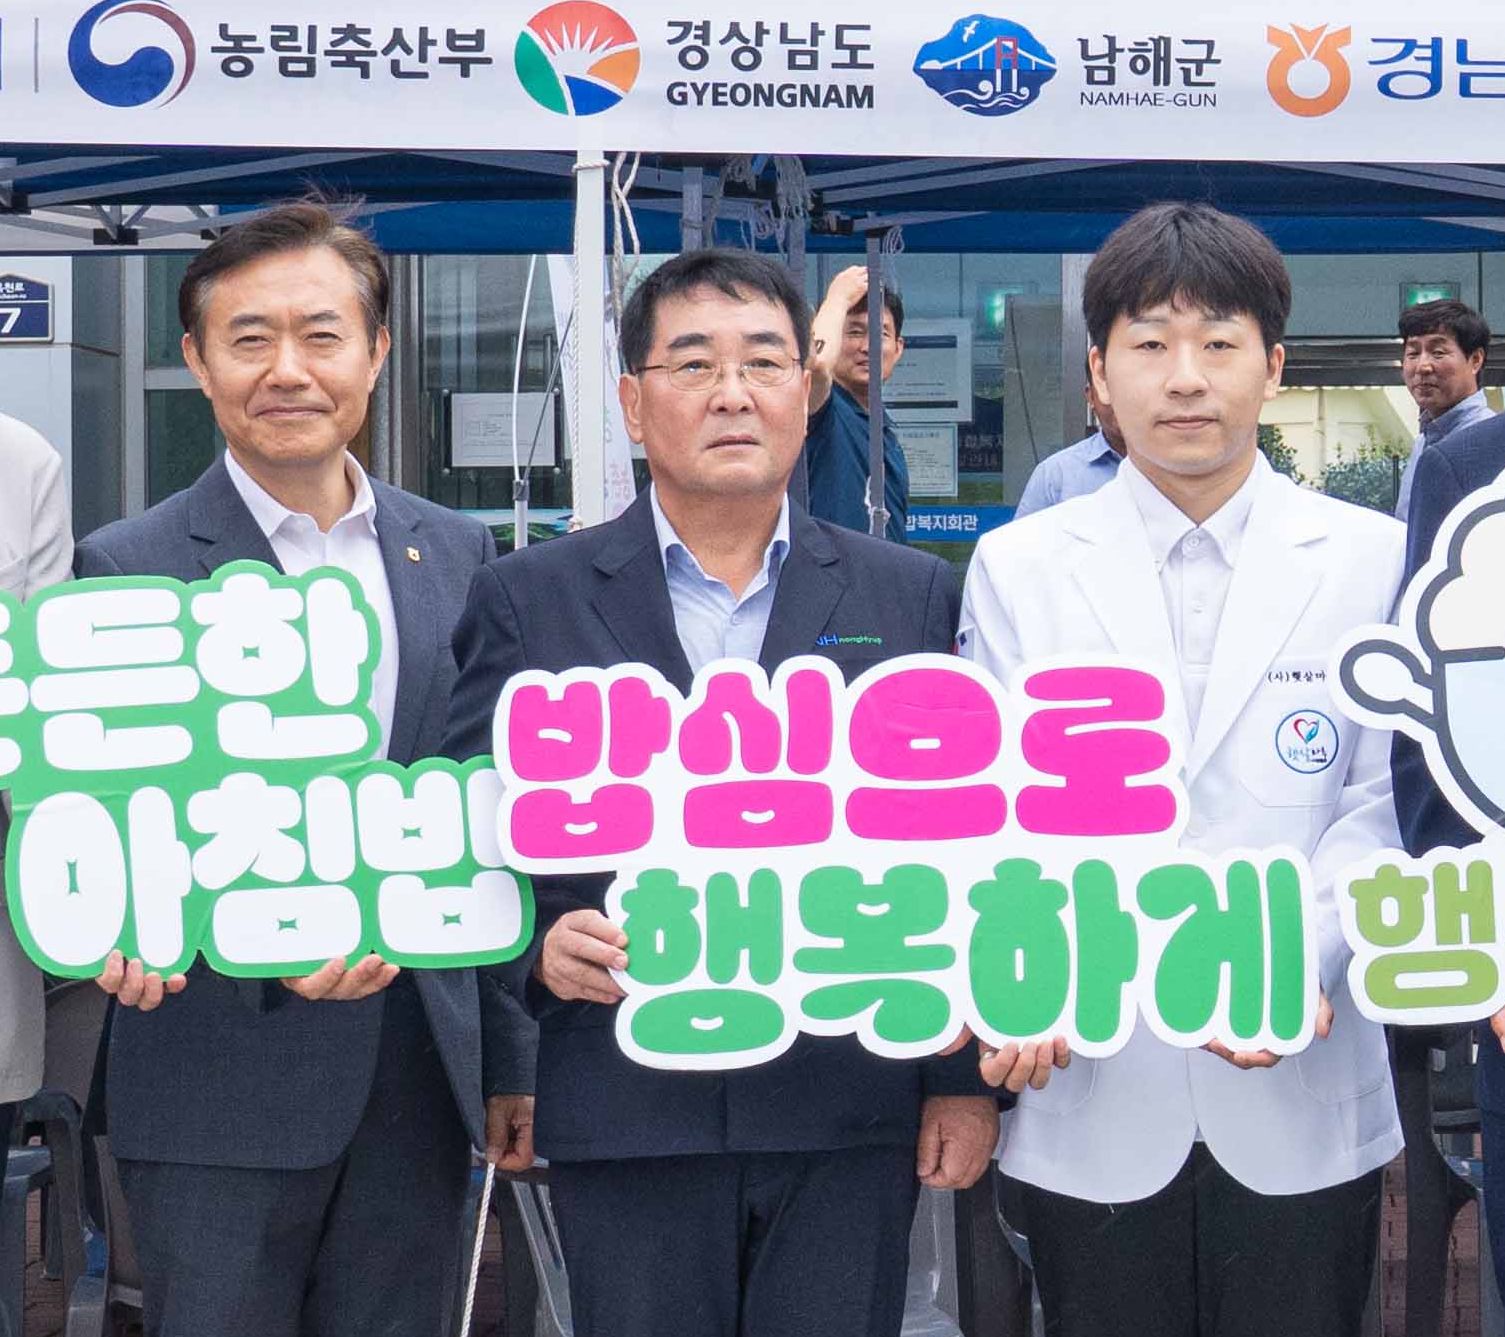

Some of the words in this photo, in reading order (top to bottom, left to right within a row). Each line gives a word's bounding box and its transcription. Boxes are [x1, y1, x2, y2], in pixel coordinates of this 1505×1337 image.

[211, 24, 492, 79] 농림축산부
[668, 21, 874, 71] 경상남도
[1078, 35, 1221, 86] 남해군
[667, 82, 873, 108] GYEONGNAM
[1081, 92, 1216, 106] NAMHAE-GUN
[509, 668, 1173, 858] 밥심으로
[621, 858, 1305, 1053] 행복하게
